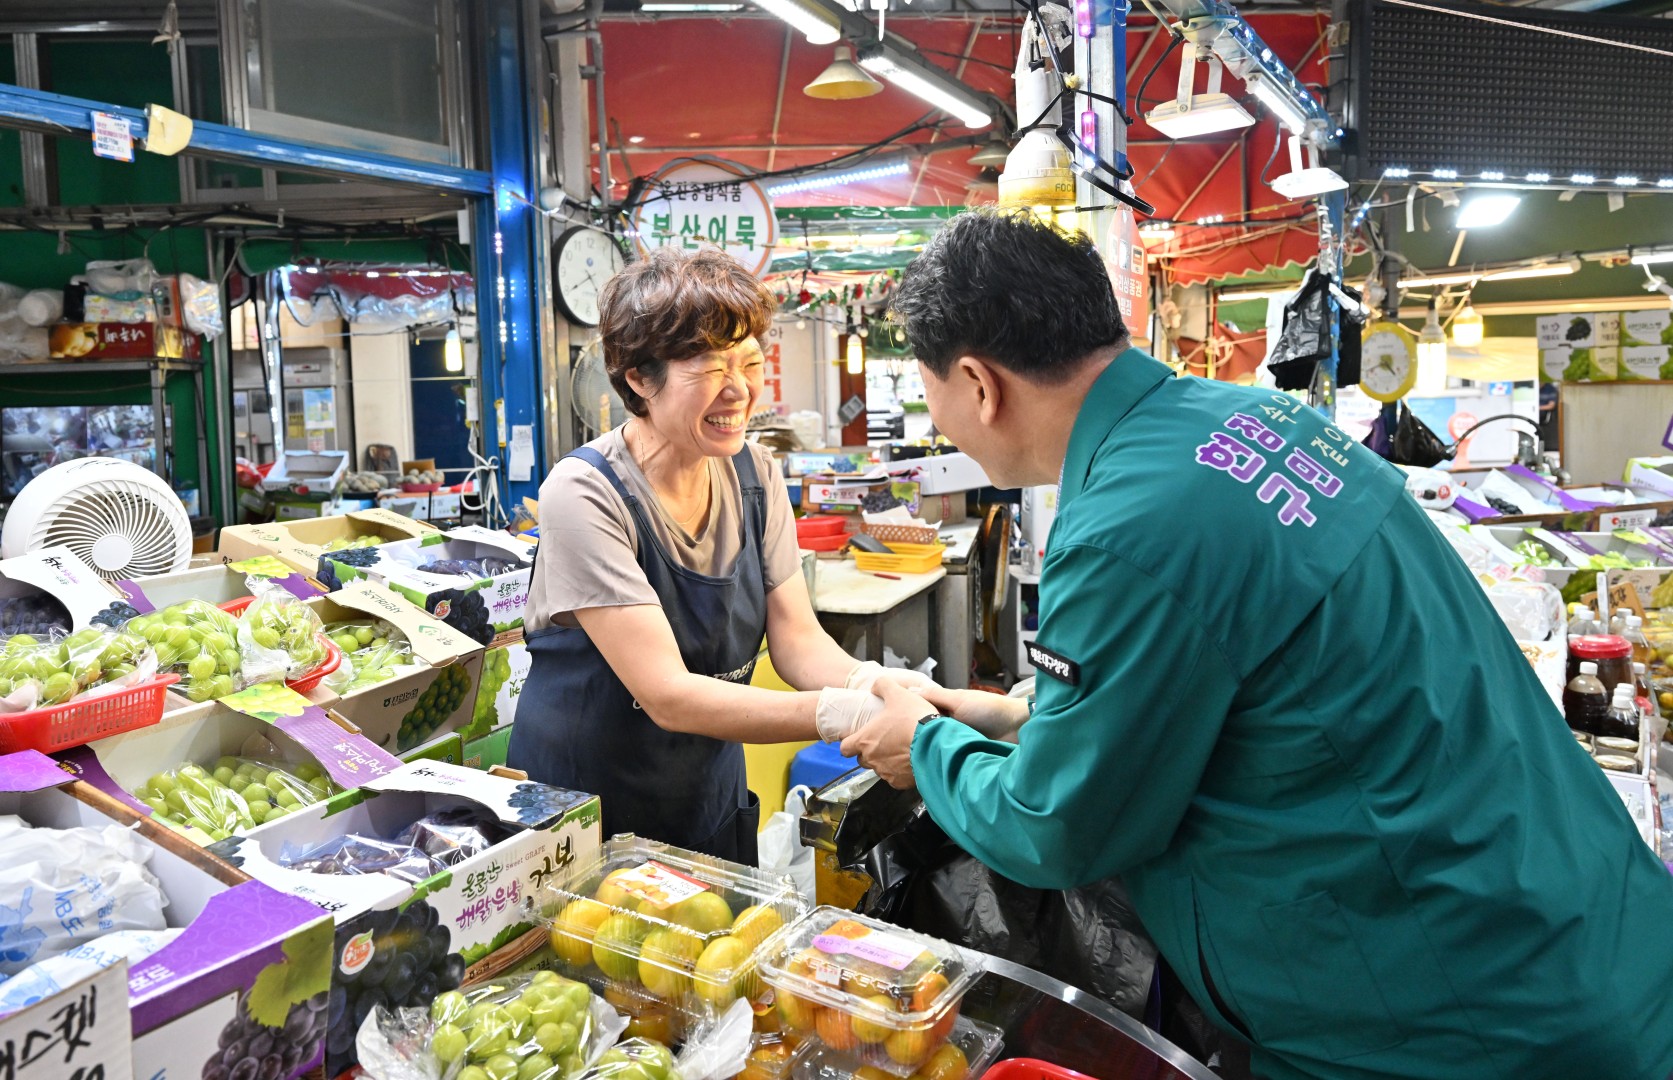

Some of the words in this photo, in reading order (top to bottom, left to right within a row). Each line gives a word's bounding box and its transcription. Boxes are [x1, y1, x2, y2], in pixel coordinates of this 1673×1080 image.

[651, 213, 757, 251] 부산어묵
[1195, 411, 1287, 484] 현장
[1259, 395, 1307, 424] 속으
[1256, 446, 1345, 528] 구민
[1310, 426, 1354, 468] 곁으
[1030, 647, 1070, 678] 해운대구청장
[505, 857, 523, 871] Sweet
[524, 844, 546, 861] GRAPE
[461, 859, 503, 899] 운문산
[455, 879, 522, 929] 해맑은날
